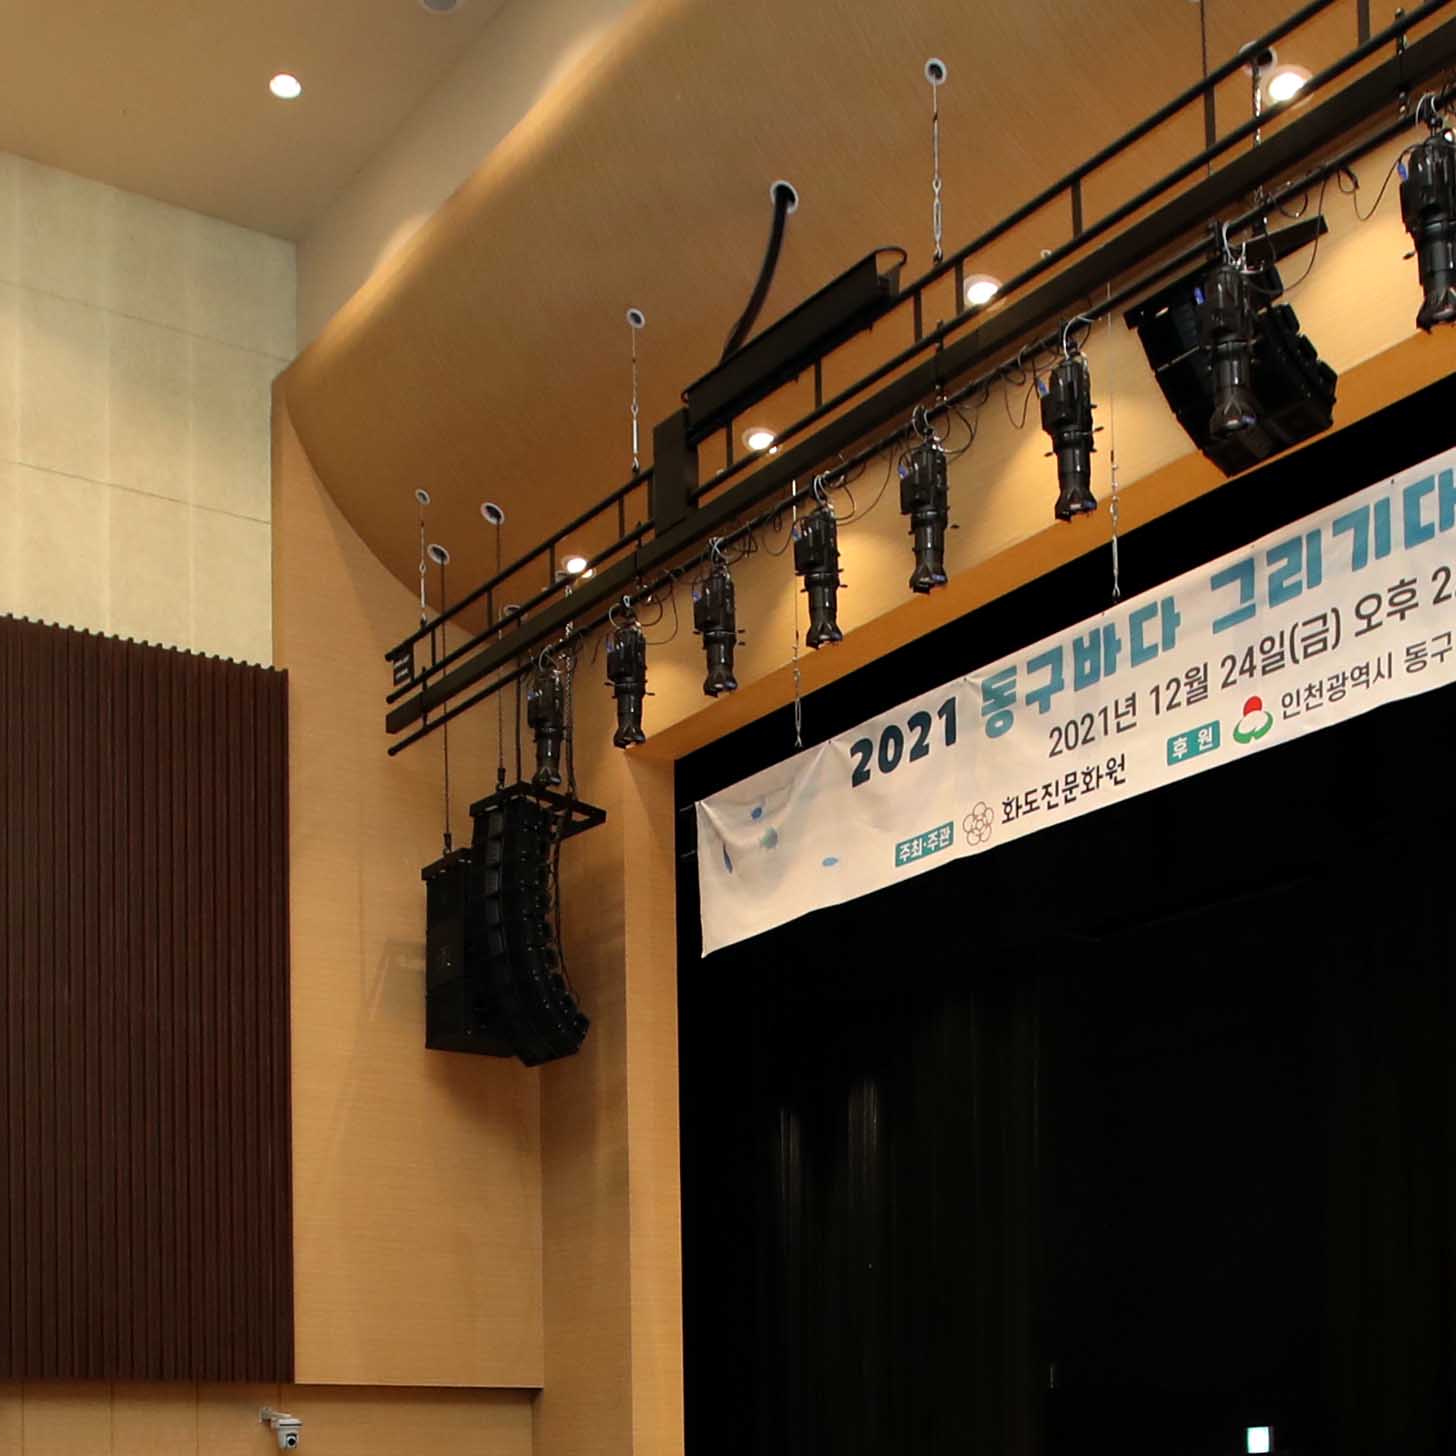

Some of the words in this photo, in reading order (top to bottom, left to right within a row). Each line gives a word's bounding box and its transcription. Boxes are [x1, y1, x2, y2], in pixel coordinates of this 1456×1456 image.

[850, 696, 959, 789] 2021
[981, 597, 1181, 740] 동구바다
[1048, 693, 1137, 759] 2021년
[1150, 665, 1210, 717] 12월
[1220, 607, 1341, 692] 24일(금)
[1353, 579, 1419, 640] 오후
[1281, 653, 1394, 719] 인천광역시
[1404, 632, 1454, 678] 동구
[1001, 754, 1128, 826] 화도진문화원
